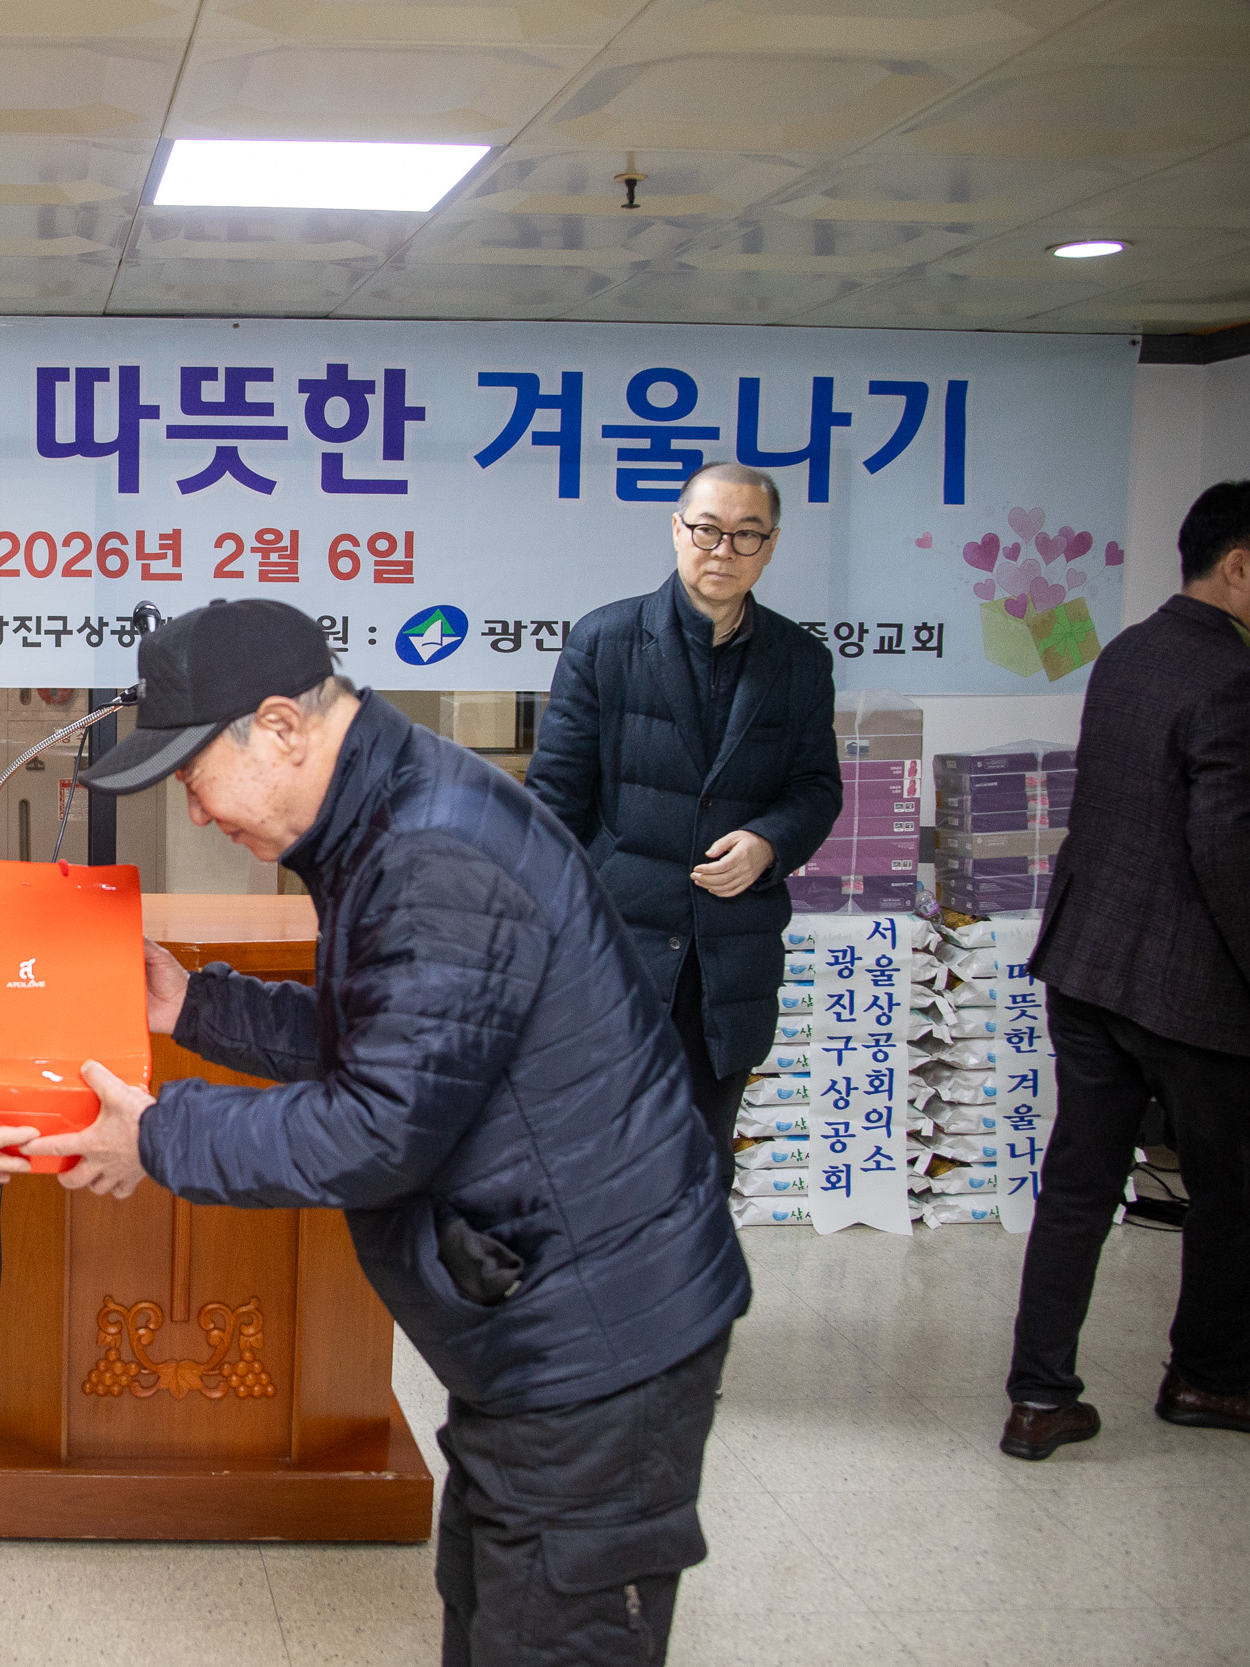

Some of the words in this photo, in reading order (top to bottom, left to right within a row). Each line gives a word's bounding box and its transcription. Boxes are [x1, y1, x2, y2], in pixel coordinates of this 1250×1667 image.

[36, 363, 426, 495] 따뜻한
[473, 367, 969, 505] 겨울나기
[213, 527, 300, 583] 2월
[328, 530, 415, 584] 6일
[819, 945, 863, 1198] 광진구상공회
[859, 917, 901, 1173] 서울상공회의소
[1002, 1068, 1044, 1201] 겨울나기
